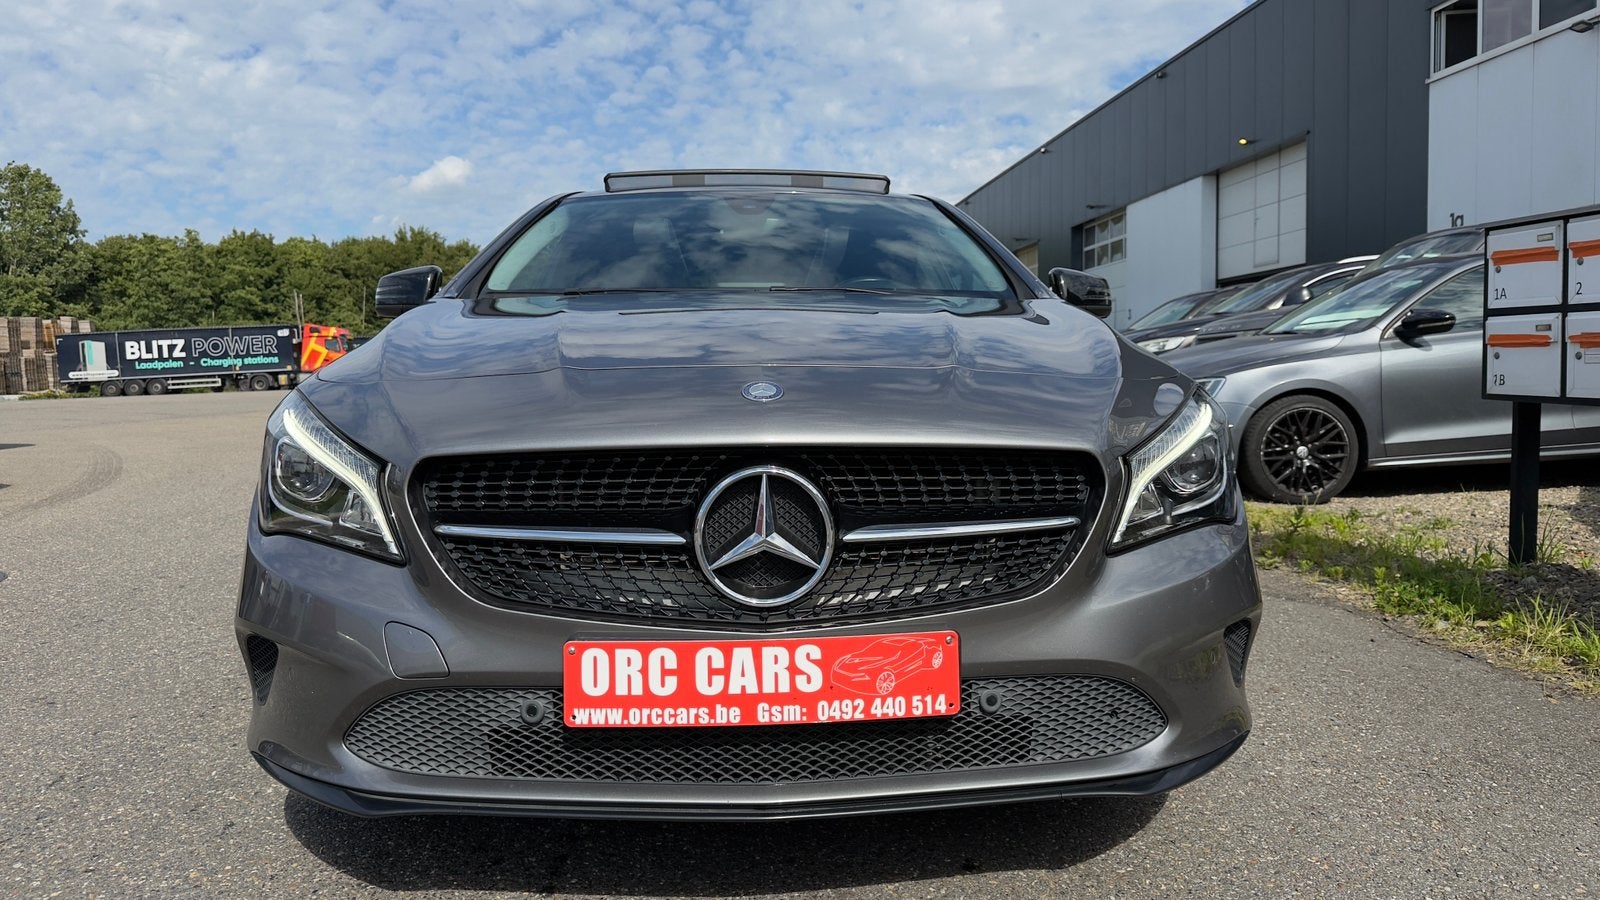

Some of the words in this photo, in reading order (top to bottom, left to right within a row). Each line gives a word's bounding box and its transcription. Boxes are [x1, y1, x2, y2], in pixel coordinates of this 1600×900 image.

[1494, 287, 1507, 300] 1A
[1576, 281, 1583, 295] 2
[125, 339, 187, 360] BLITZ
[191, 335, 278, 357] POWER
[135, 359, 184, 370] Laadpalen
[200, 356, 242, 367] Charging
[243, 355, 279, 365] stations
[580, 648, 678, 696] ORC
[695, 644, 823, 695] CARS
[572, 704, 741, 725] www.orccars.be
[757, 702, 807, 722] Gsm:
[817, 698, 864, 720] 0492
[871, 696, 906, 717] 440
[912, 694, 946, 714] 514
